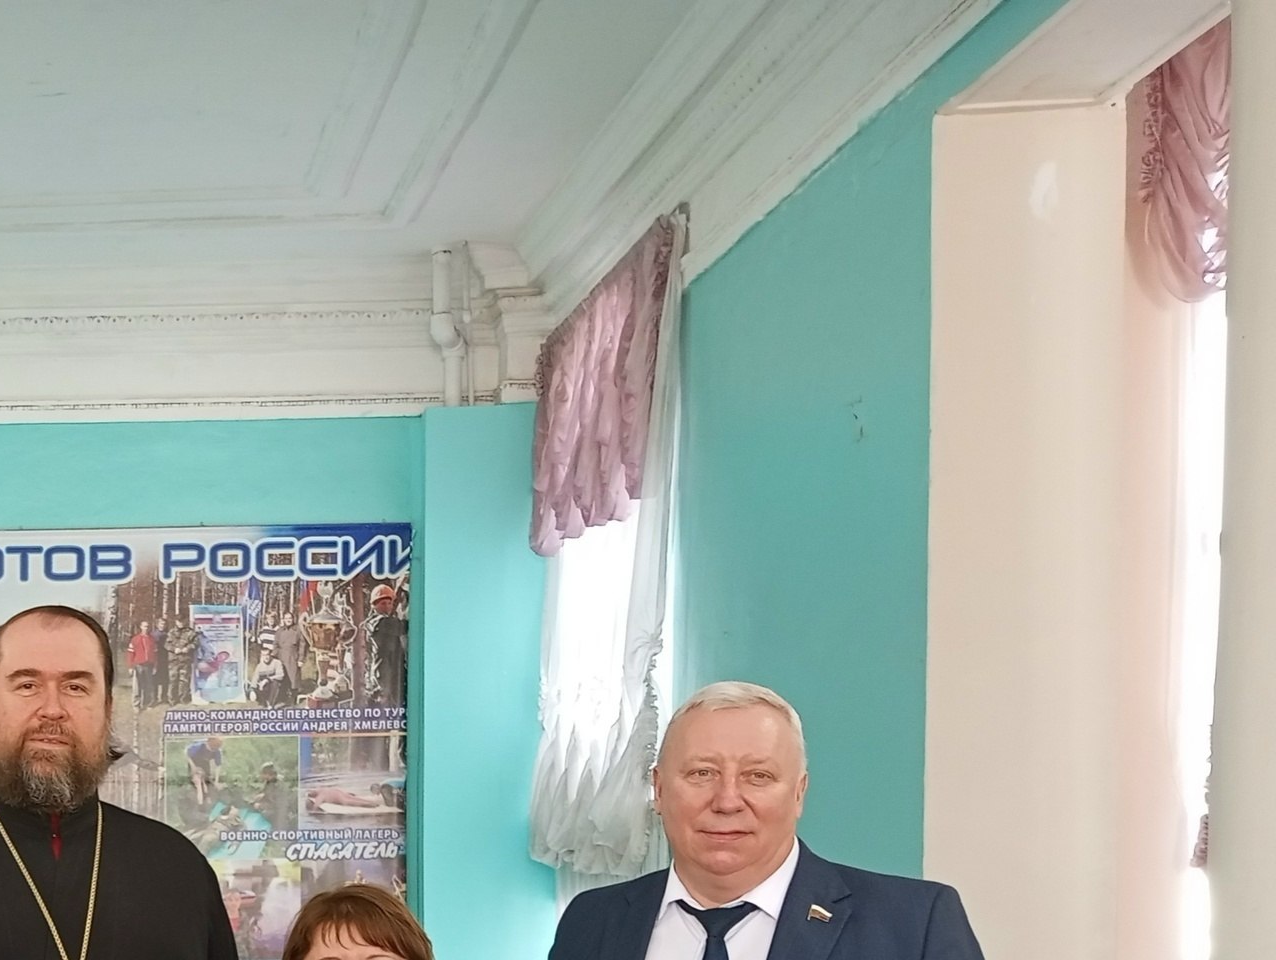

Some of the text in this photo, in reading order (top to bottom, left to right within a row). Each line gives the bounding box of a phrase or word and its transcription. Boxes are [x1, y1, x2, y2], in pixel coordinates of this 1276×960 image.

[165, 708, 284, 722] ЛИЧНО-КОМАНДНОЕ
[286, 708, 361, 720] ПЕРВЕНСТВО
[364, 707, 381, 718] ПО
[164, 720, 407, 733] ПАМЯТИ ГЕРОЯ РОССИИ АНДРЕЯ ХМЕЛЕВС
[220, 828, 399, 842] ВОЕННО-СПОРТИВНЫЙ ЛАГЕРЬ
